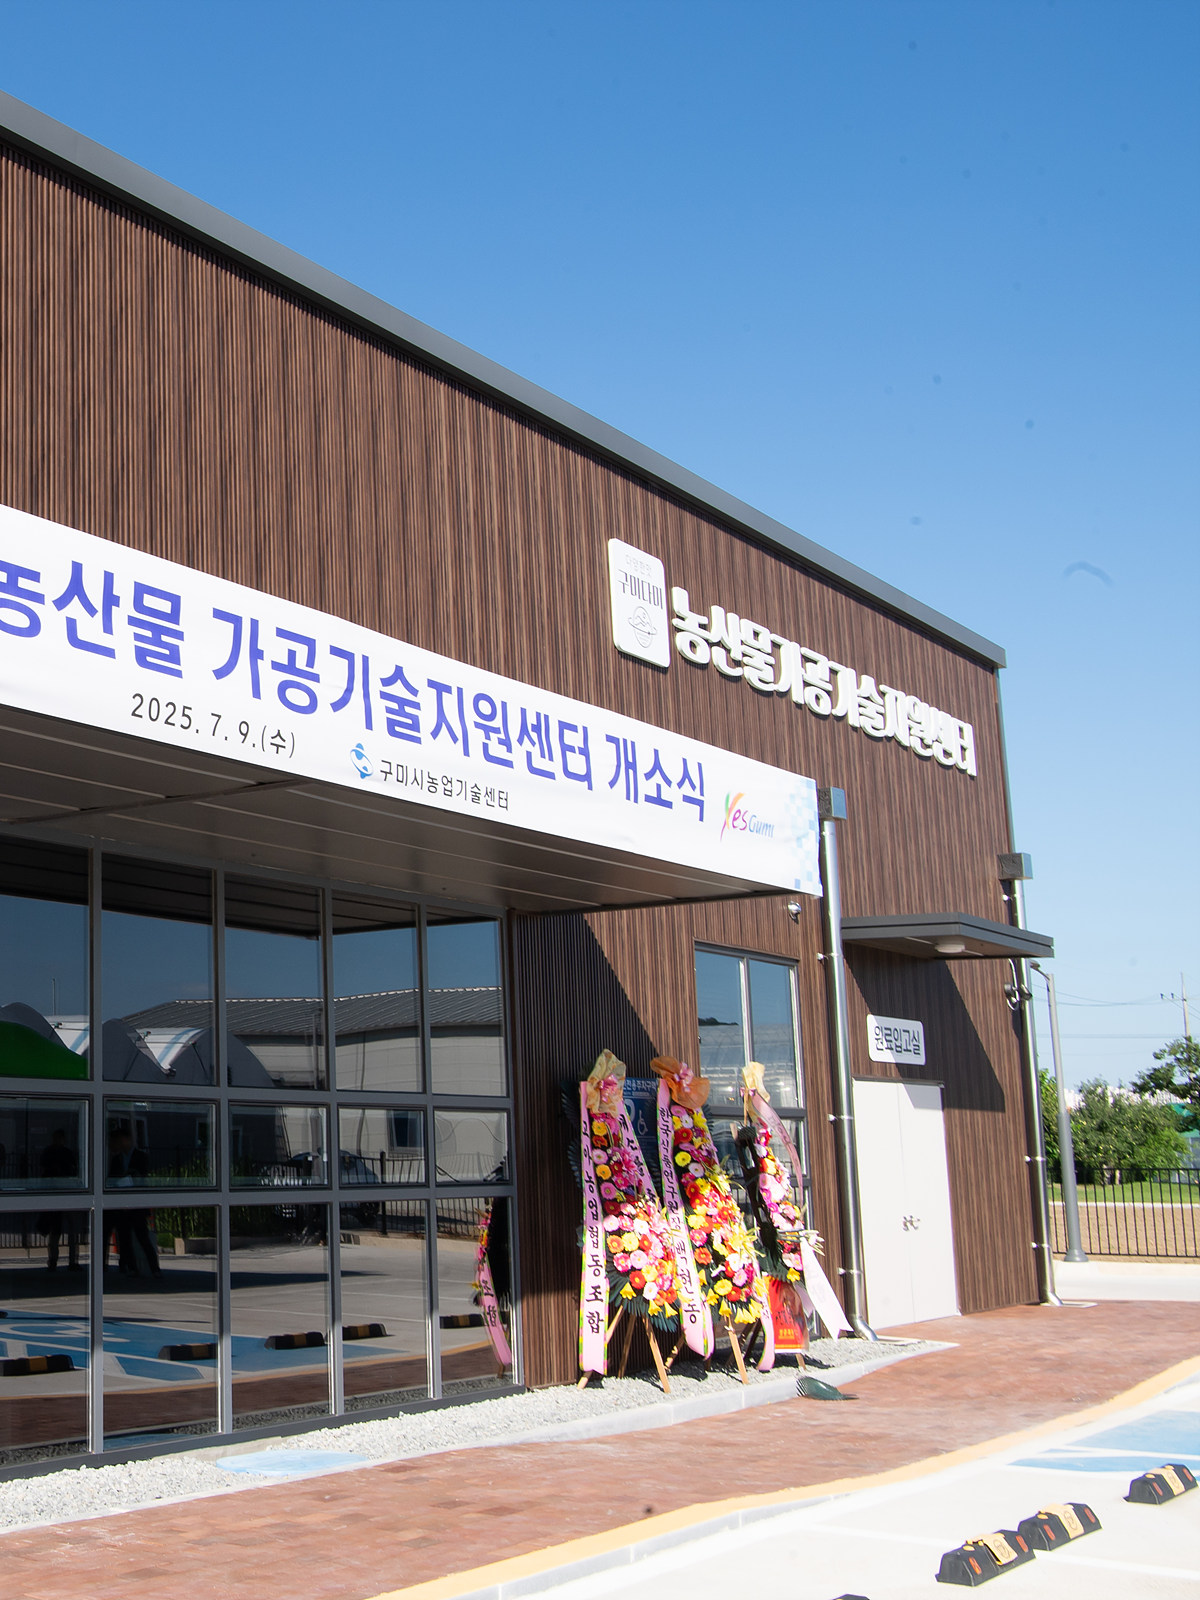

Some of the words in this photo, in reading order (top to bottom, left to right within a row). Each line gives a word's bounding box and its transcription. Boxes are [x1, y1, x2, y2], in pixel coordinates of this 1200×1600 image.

[618, 568, 663, 610] 구미다미
[671, 586, 977, 777] 농산물가공기술지원센터
[212, 607, 595, 793] 가공기술지원센터
[606, 733, 706, 823] 개소식
[379, 759, 510, 812] 구미시농업기술센터
[874, 1025, 921, 1055] 원료입고실
